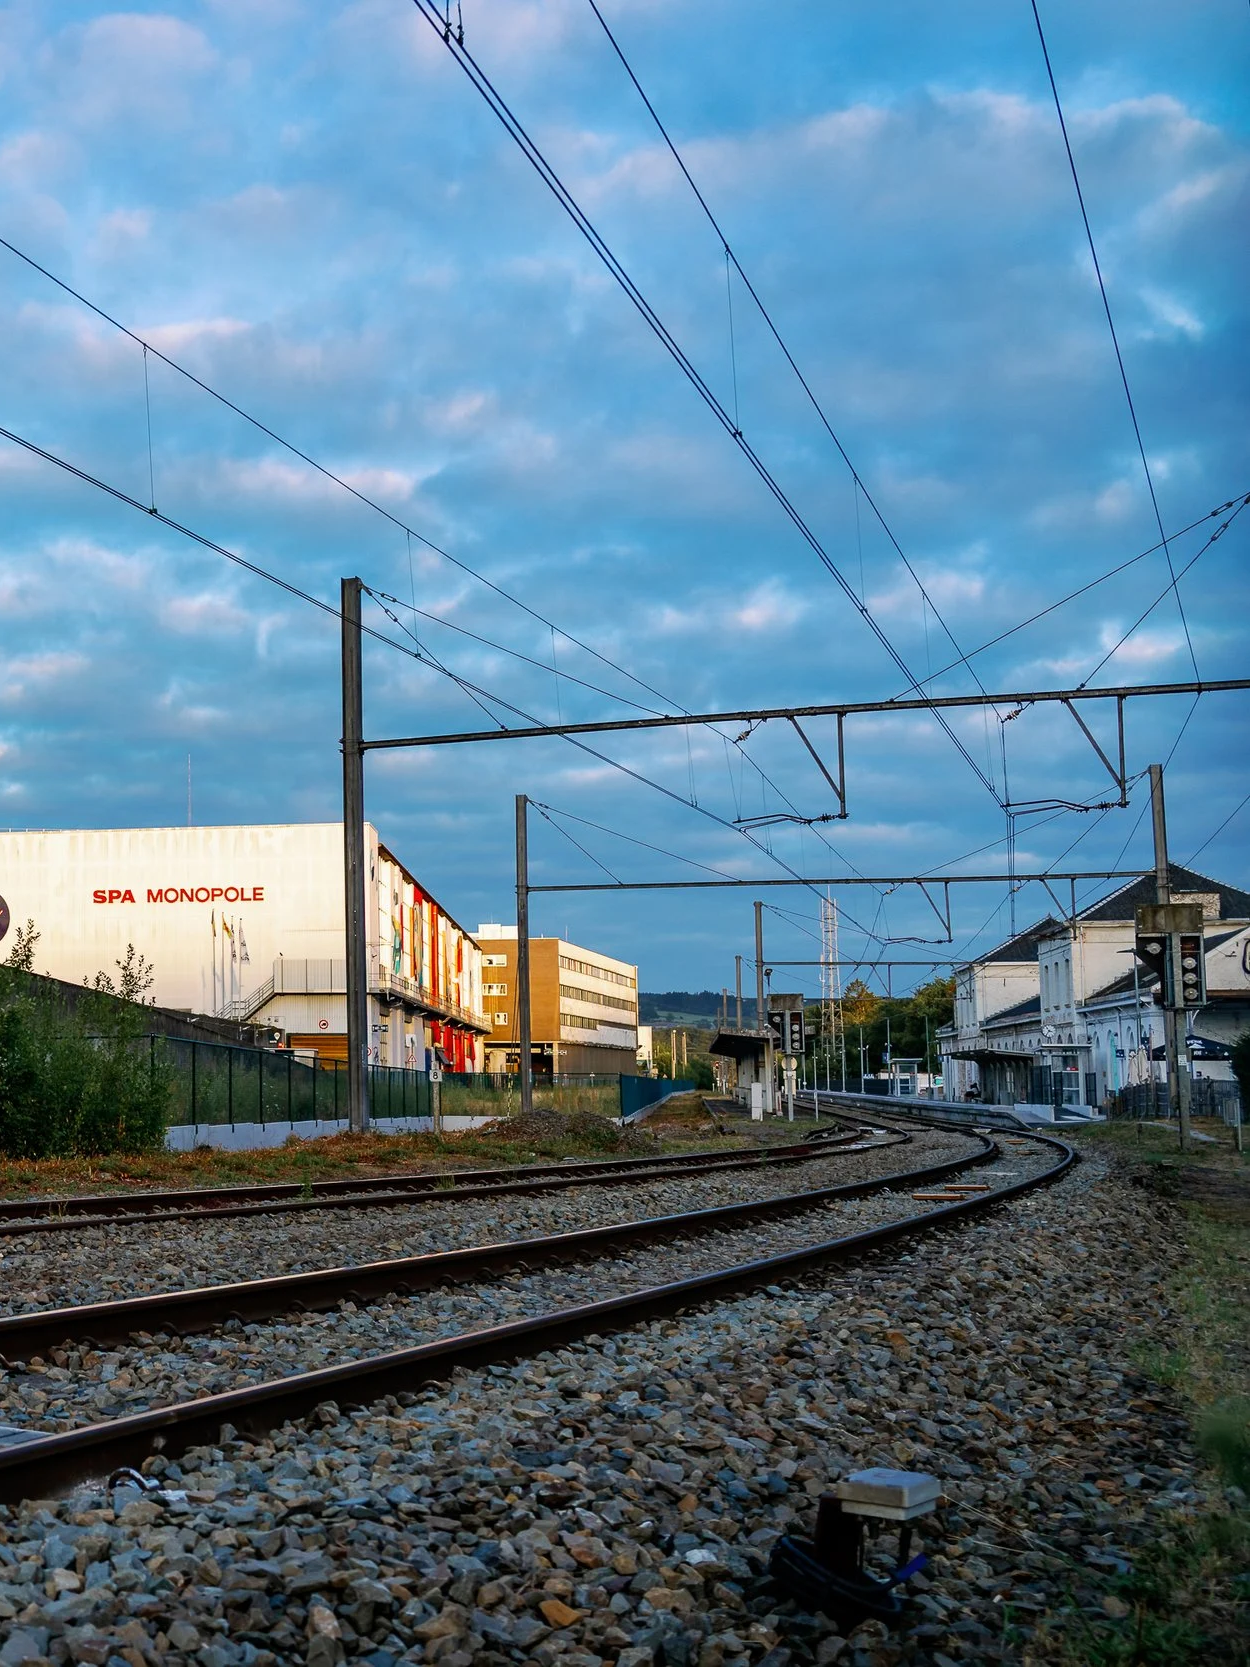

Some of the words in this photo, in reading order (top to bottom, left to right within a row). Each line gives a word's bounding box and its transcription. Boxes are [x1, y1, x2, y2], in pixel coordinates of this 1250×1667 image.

[93, 889, 136, 904] SPA
[147, 886, 265, 904] MONOPOLE
[432, 1071, 439, 1080] 8
